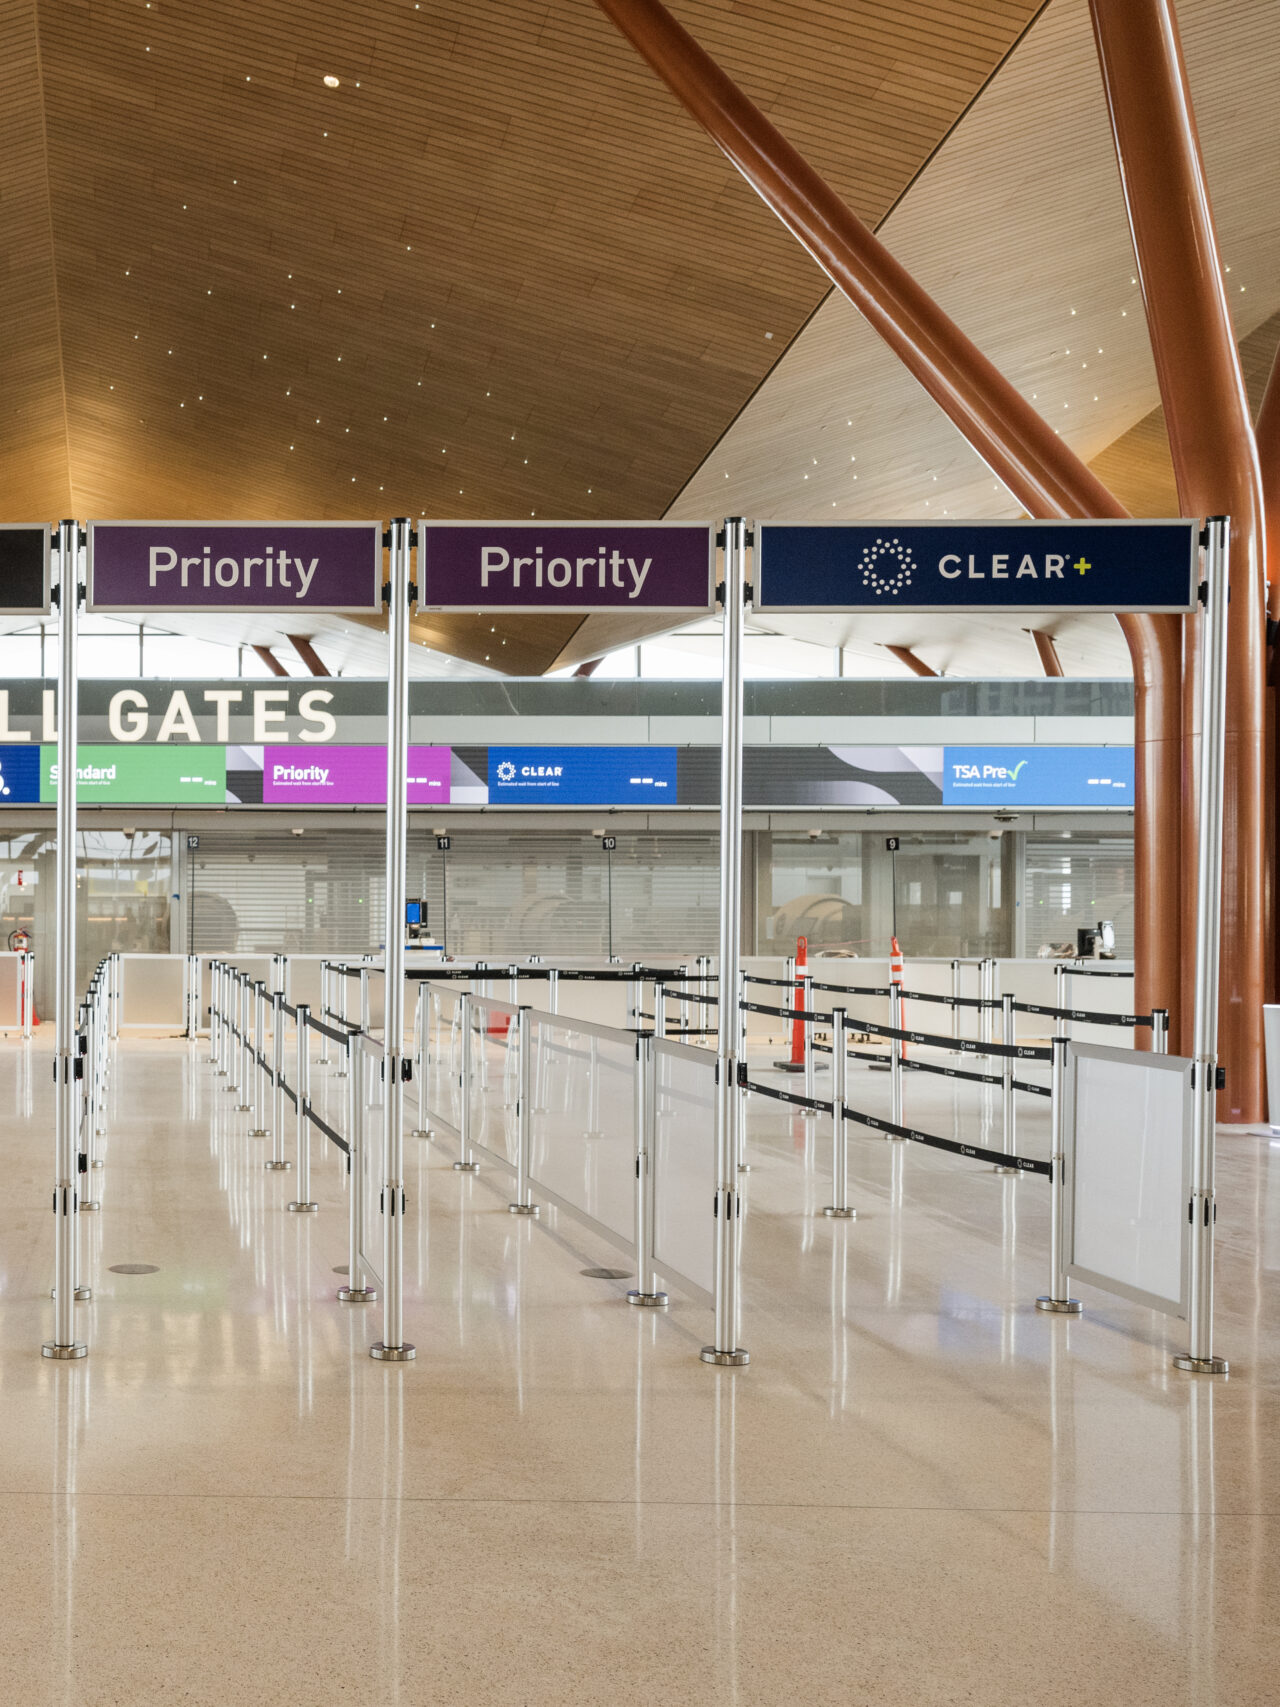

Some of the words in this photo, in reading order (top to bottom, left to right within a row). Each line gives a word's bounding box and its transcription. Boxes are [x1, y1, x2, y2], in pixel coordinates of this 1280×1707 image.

[149, 546, 320, 599] Priority
[480, 546, 653, 599] Priority
[108, 689, 337, 742] GATES
[49, 764, 116, 780] Sndard
[272, 764, 330, 783] Priority
[521, 766, 562, 777] CLEAR
[952, 765, 980, 779] TSA
[189, 837, 198, 847] 12
[439, 838, 448, 848] 11
[605, 838, 615, 848] 10
[889, 839, 896, 849] 9
